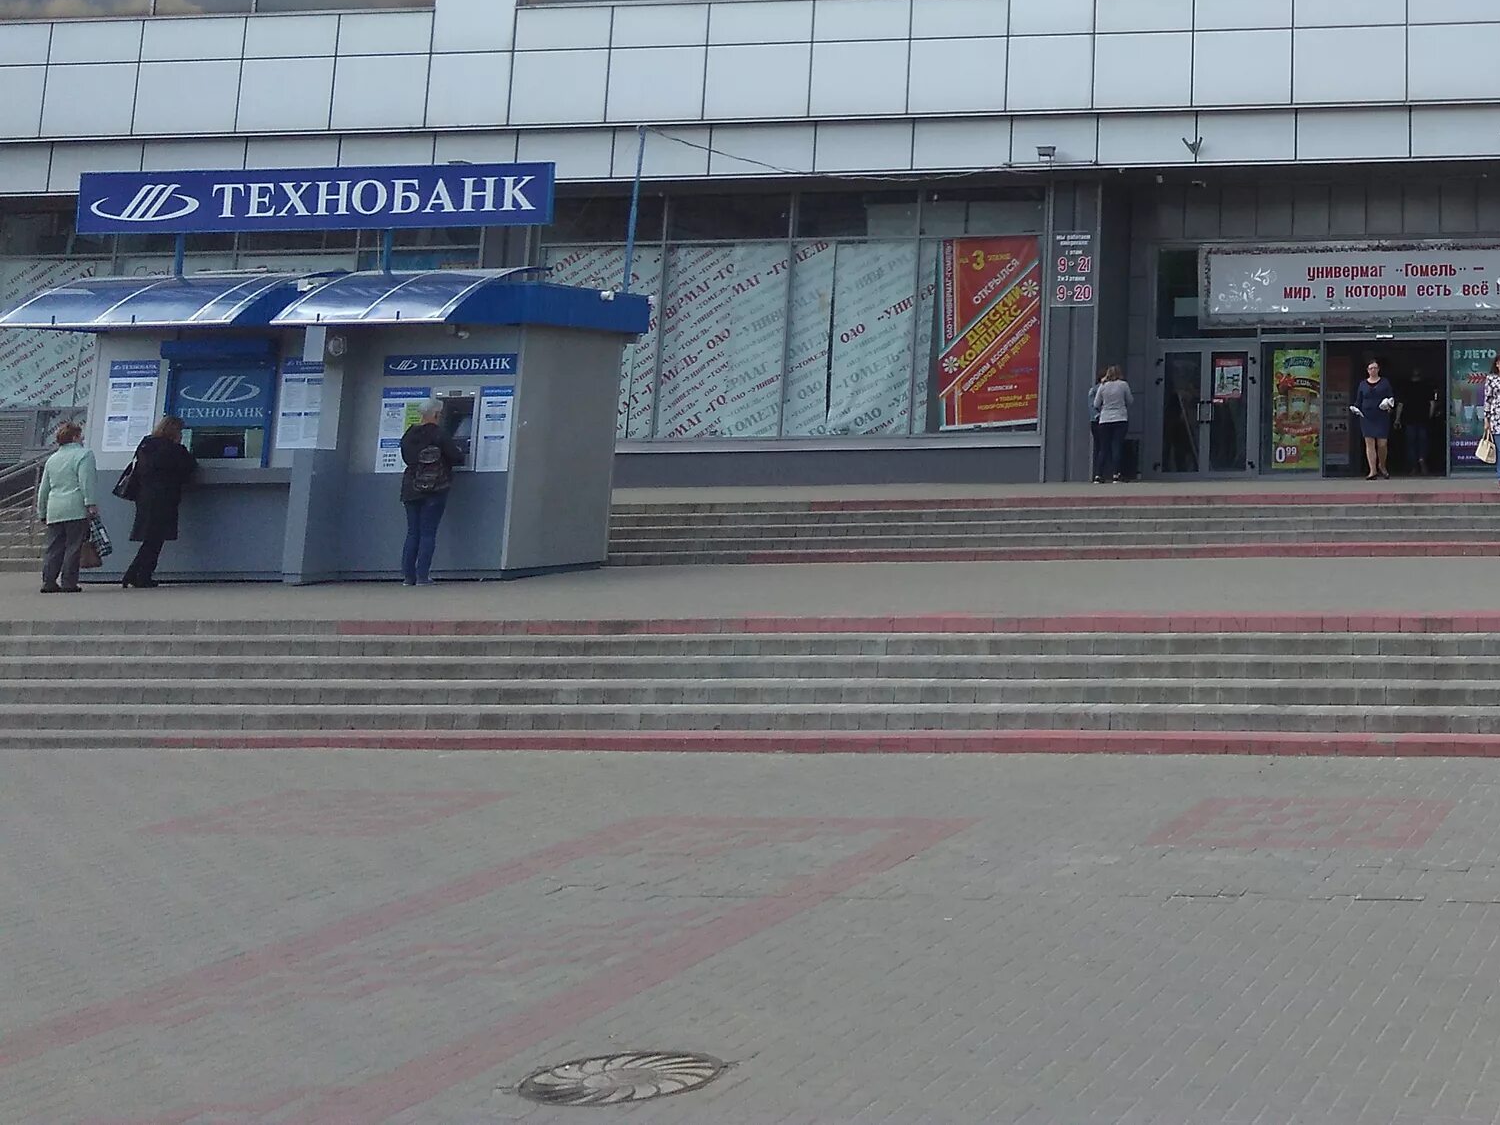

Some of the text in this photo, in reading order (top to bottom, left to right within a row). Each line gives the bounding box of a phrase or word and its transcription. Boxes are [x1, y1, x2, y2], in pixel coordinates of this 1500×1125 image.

[211, 175, 536, 219] ТЕХНОБАНК
[972, 250, 985, 271] 3
[972, 258, 1020, 305] ОТКРЫЛСЯ
[1307, 265, 1386, 281] универмаг
[1326, 286, 1335, 299] в
[1345, 284, 1406, 300] котором
[1416, 284, 1452, 297] есть
[1462, 280, 1489, 296] всё
[706, 328, 731, 351] ОАО
[840, 323, 866, 344] ОАО
[958, 305, 1022, 368] КОМПЛЕКС
[1463, 348, 1497, 359] ЛЕТО
[421, 358, 511, 370] ТЕХНОБАНК
[178, 407, 263, 419] ТЕХНОБАНК
[854, 407, 882, 427] ОАО
